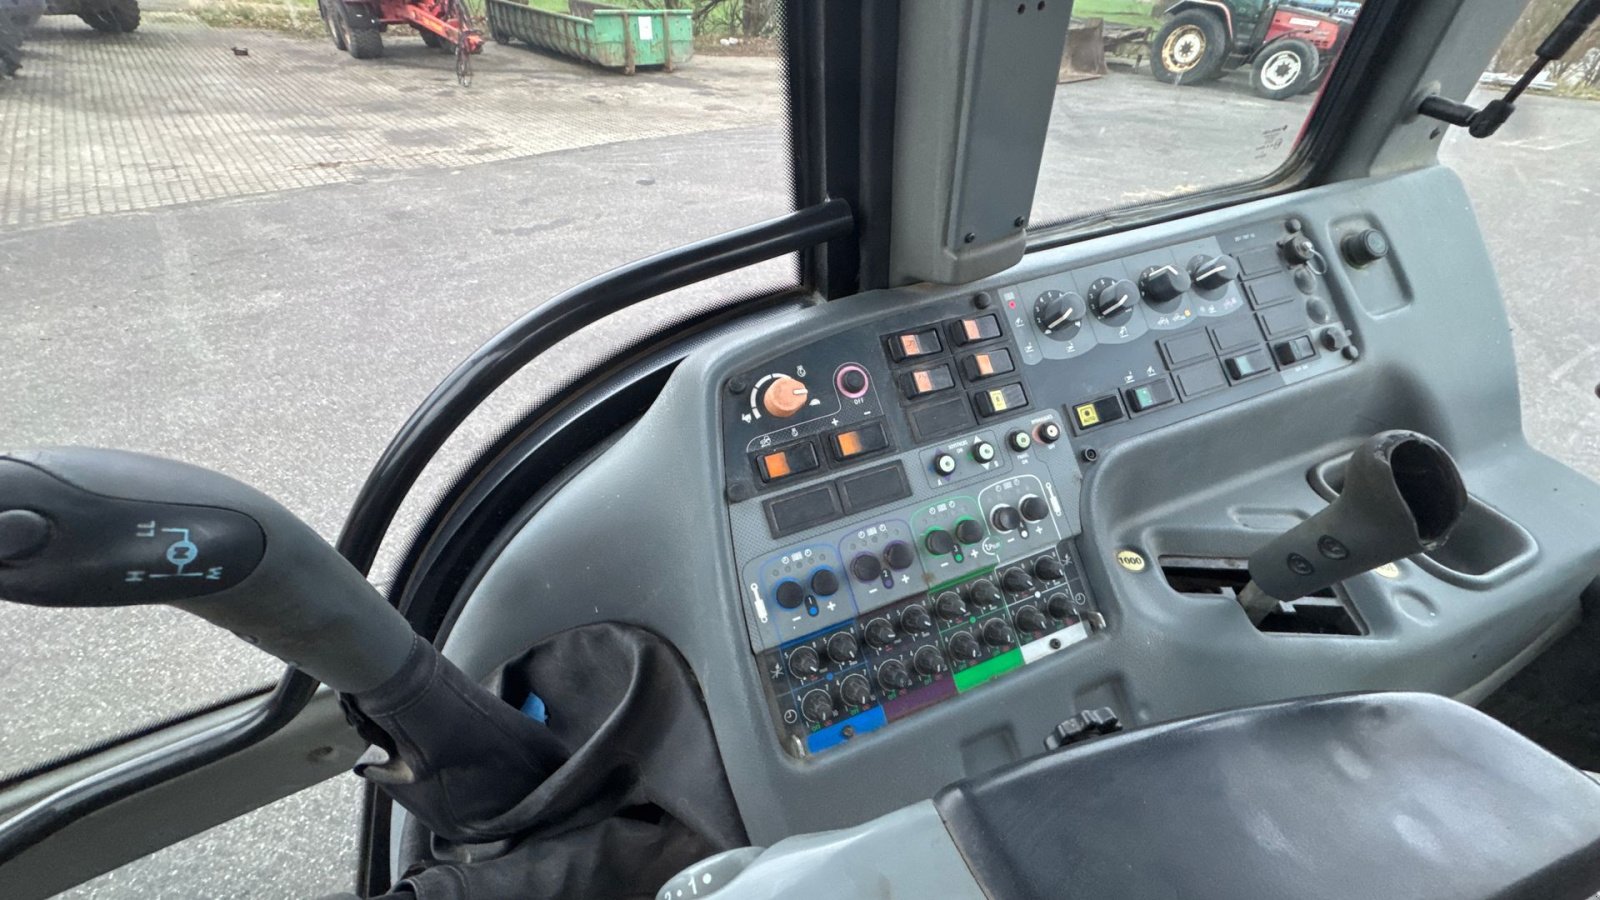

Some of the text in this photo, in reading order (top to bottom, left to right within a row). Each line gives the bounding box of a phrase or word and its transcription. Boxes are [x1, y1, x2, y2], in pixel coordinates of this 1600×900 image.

[937, 479, 943, 487] A
[1118, 557, 1142, 565] 1000
[125, 570, 146, 582] H
[882, 570, 888, 578] 2
[687, 876, 698, 895] 1
